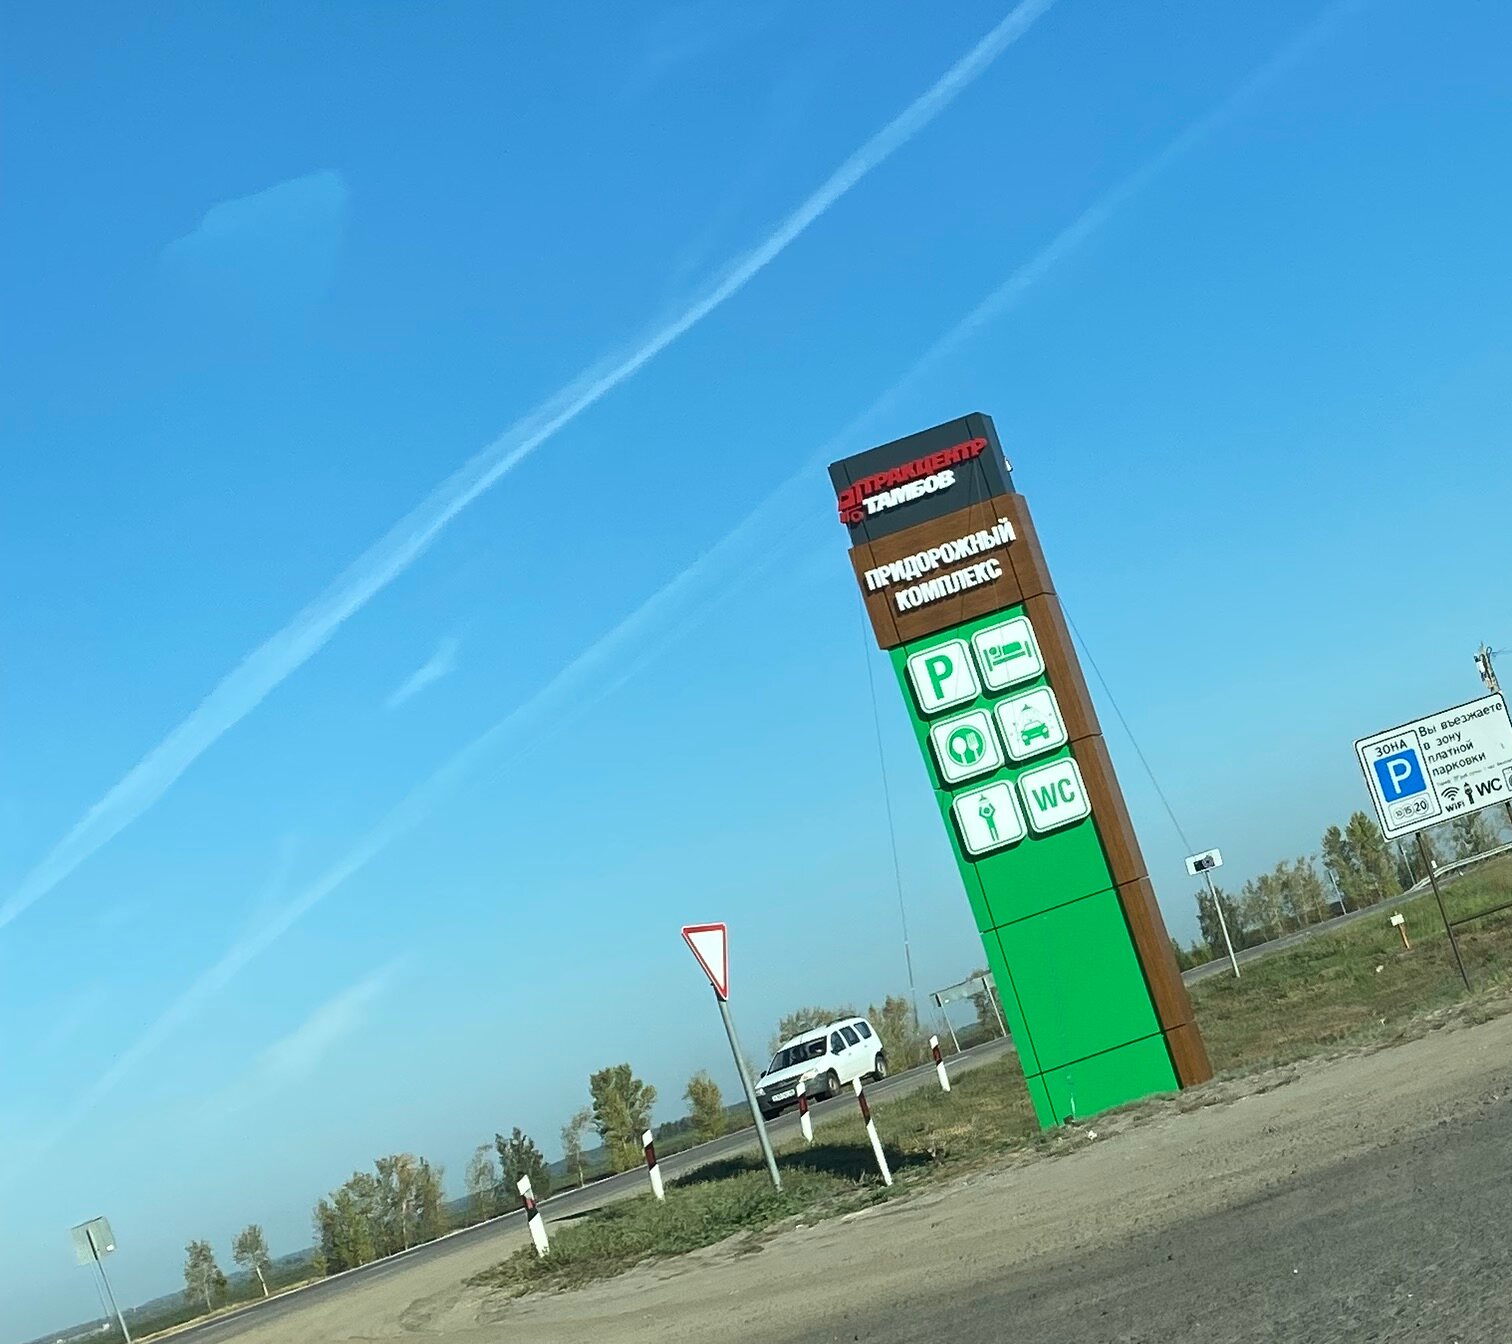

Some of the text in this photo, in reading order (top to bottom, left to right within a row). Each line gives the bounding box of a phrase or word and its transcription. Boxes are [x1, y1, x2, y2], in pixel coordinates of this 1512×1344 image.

[862, 469, 956, 515] ТАМБОВ
[864, 517, 1017, 591] ПРИДОРОЖНЫЙ
[894, 558, 1003, 612] КОМПЛЕКС
[1418, 702, 1502, 737] Вы въезжаете
[1374, 739, 1408, 757] ЗОНА
[1428, 739, 1474, 763] платной
[1436, 731, 1461, 746] зону
[1432, 752, 1486, 777] парковки
[1032, 778, 1075, 812] WC
[1475, 777, 1503, 796] WC
[1414, 800, 1427, 812] 20
